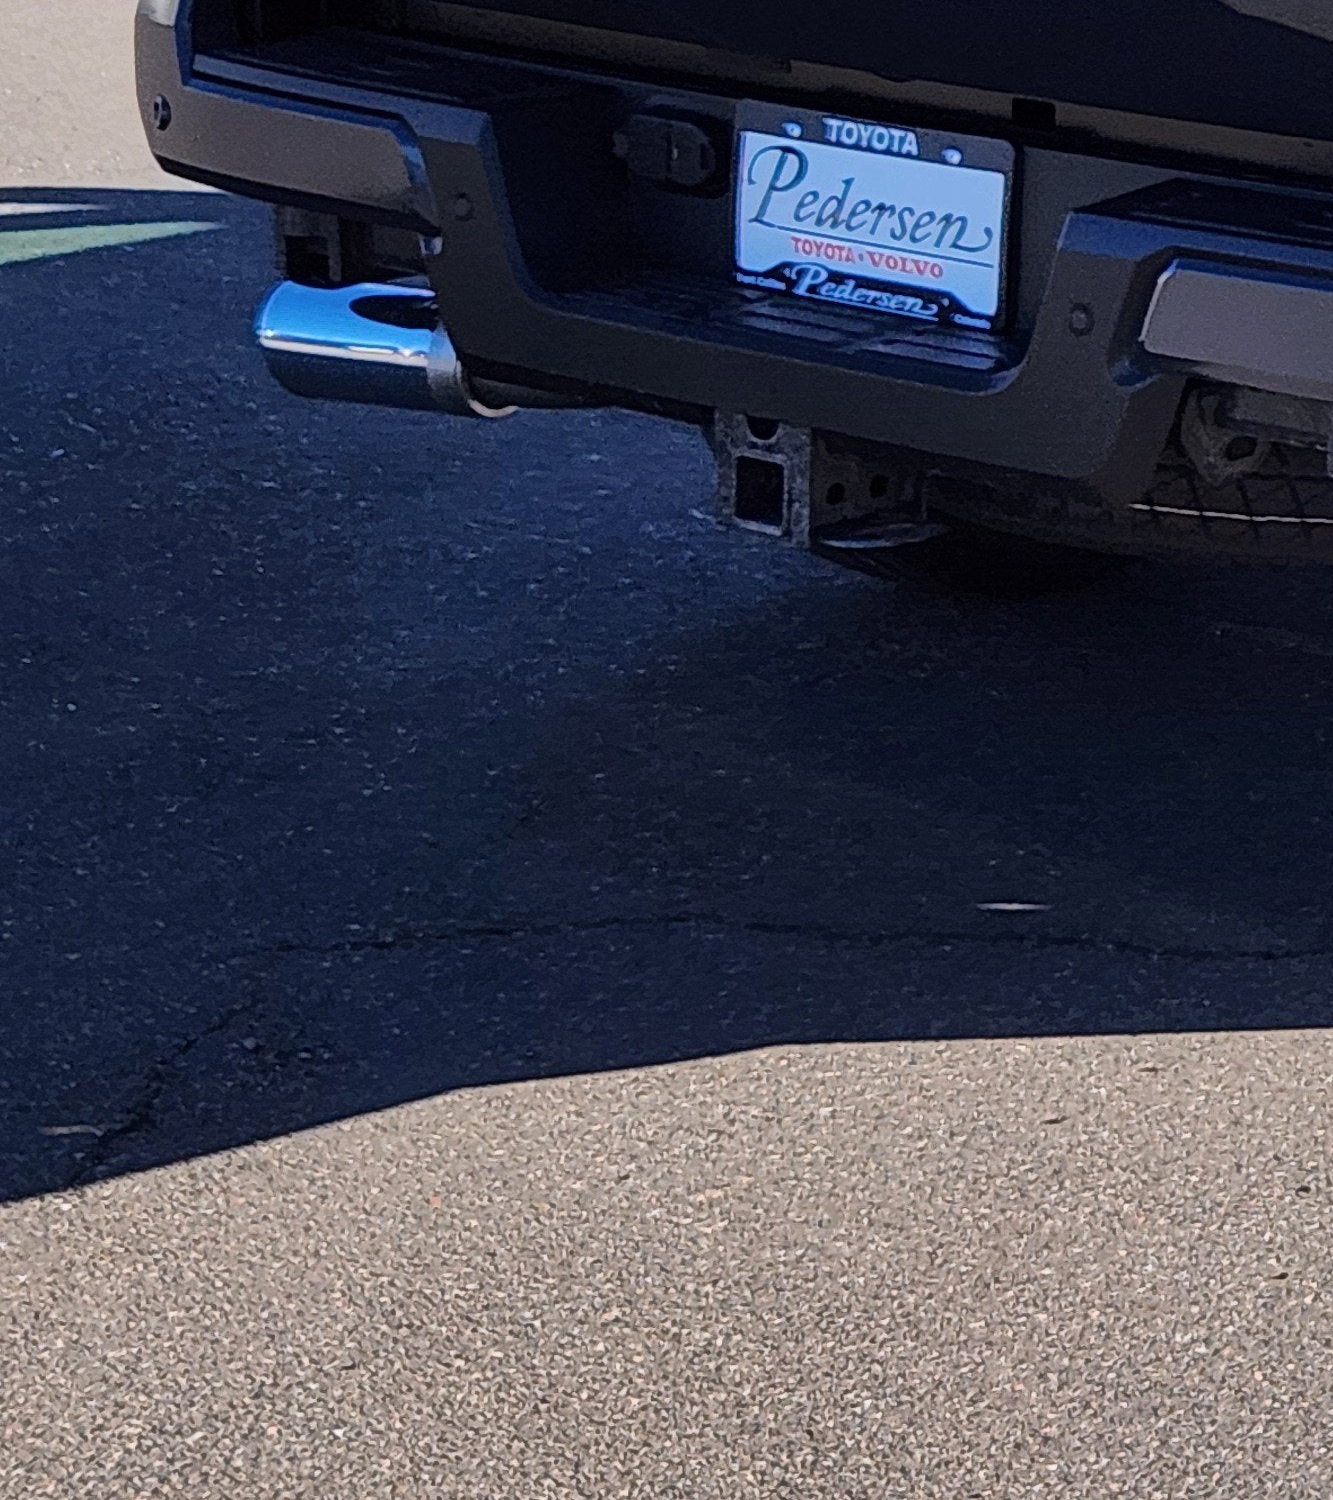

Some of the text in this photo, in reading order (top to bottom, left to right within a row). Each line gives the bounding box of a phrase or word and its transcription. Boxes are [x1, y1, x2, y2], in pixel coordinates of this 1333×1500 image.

[823, 116, 919, 157] TOYOTA
[747, 145, 994, 253] Pedersen
[791, 237, 944, 279] TOYOTA VOLVO
[790, 264, 939, 317] Pedersen
